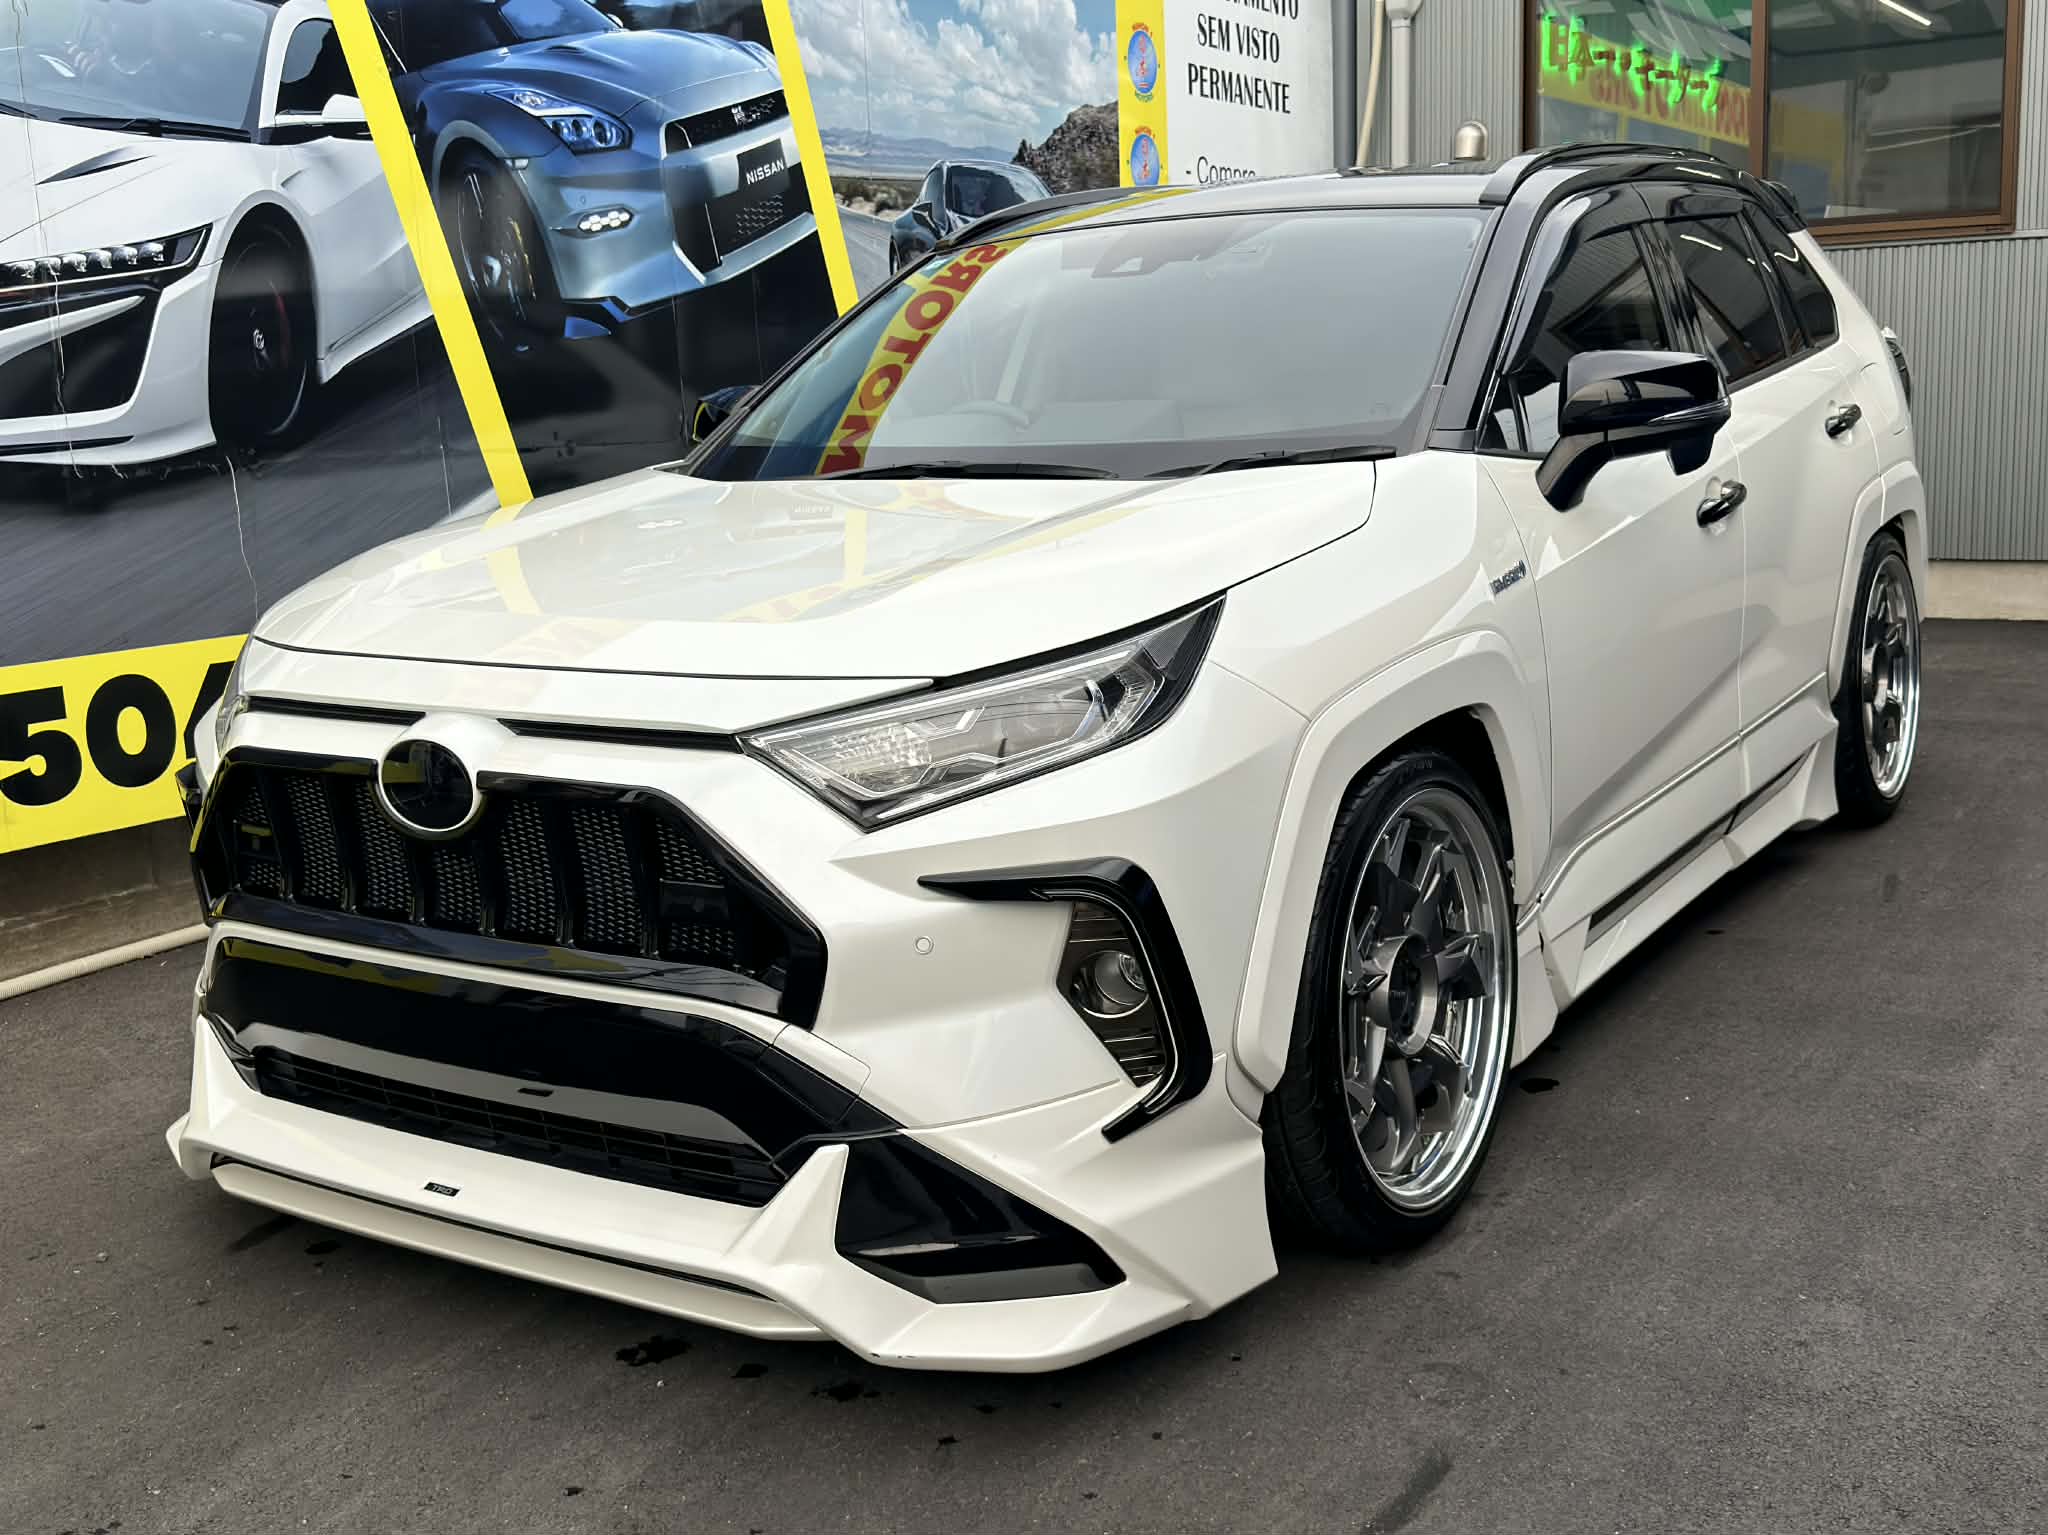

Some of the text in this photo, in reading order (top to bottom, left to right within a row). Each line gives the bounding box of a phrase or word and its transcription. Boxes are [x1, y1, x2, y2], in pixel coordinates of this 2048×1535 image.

[1197, 13, 1280, 63] SEM VISTO
[1187, 62, 1291, 114] PERMANENTE
[745, 158, 785, 185] NISSAN
[430, 1183, 456, 1196] TRD
